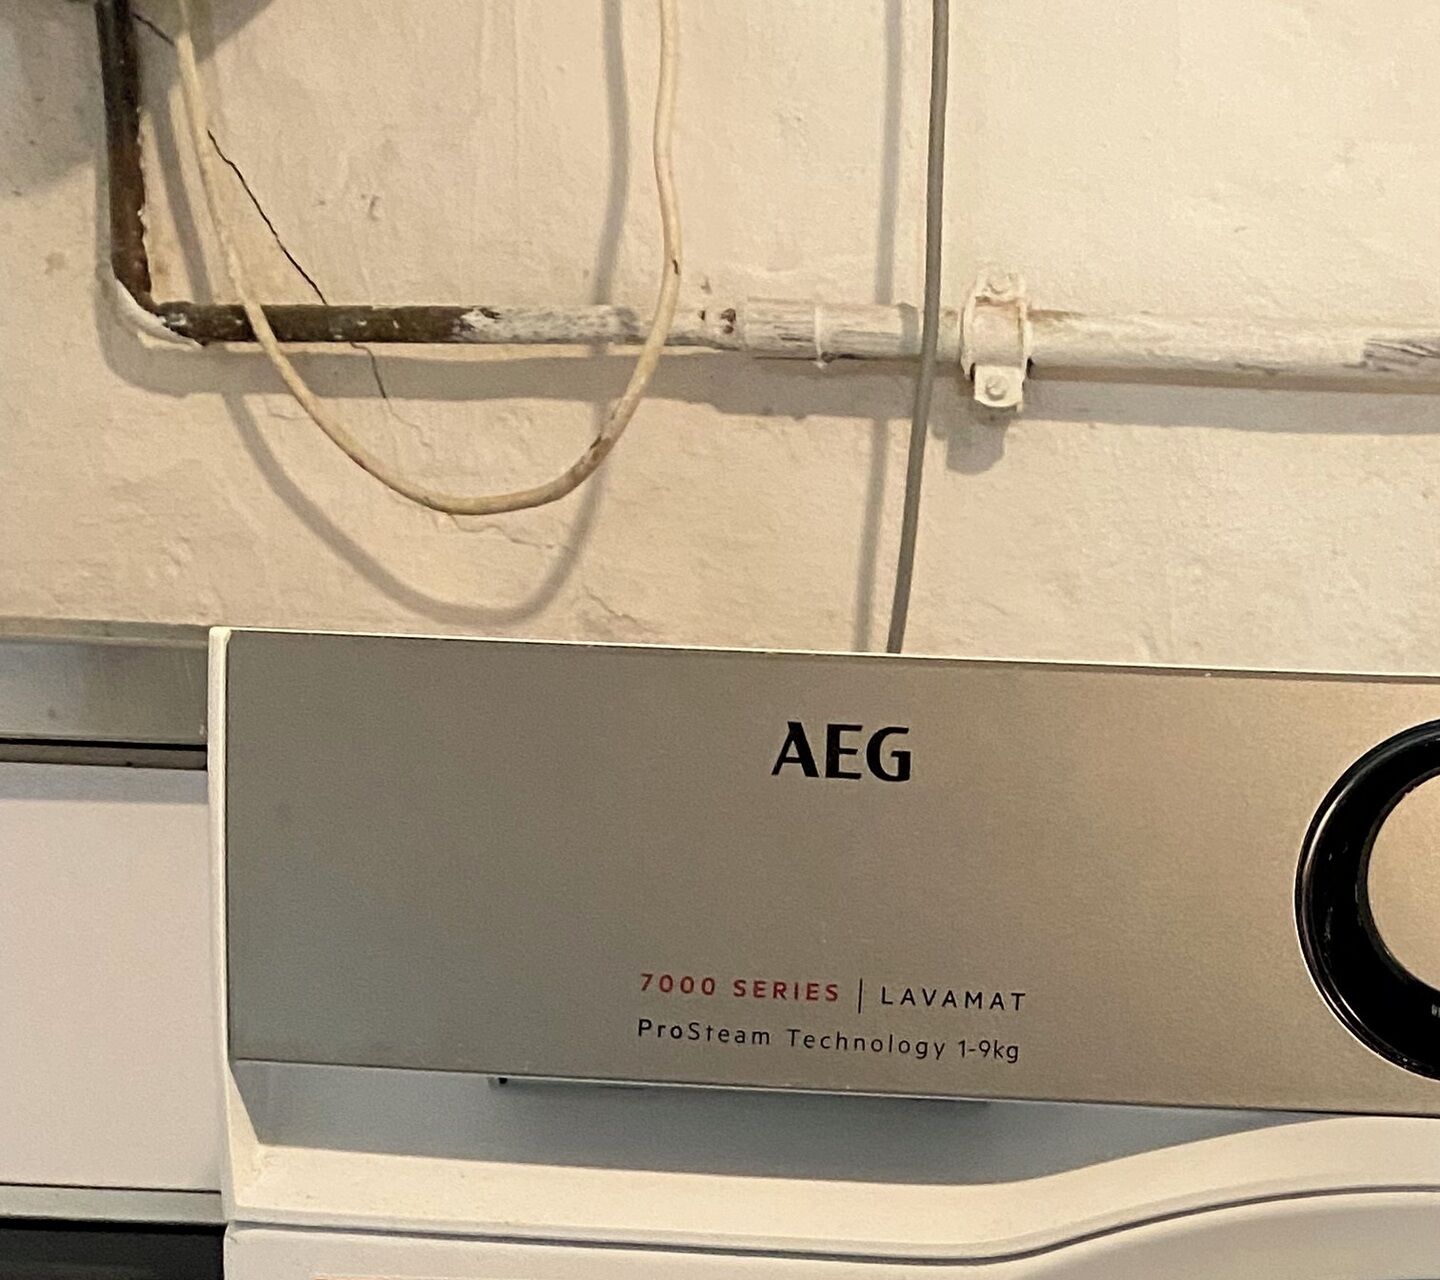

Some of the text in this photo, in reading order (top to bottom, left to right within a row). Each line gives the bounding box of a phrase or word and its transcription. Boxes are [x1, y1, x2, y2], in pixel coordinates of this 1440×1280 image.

[771, 721, 913, 782] AEG
[640, 974, 1027, 1013] 7000 SERIES LAVAMAT
[637, 1018, 1020, 1064] ProSteam Technology 1-9kg
